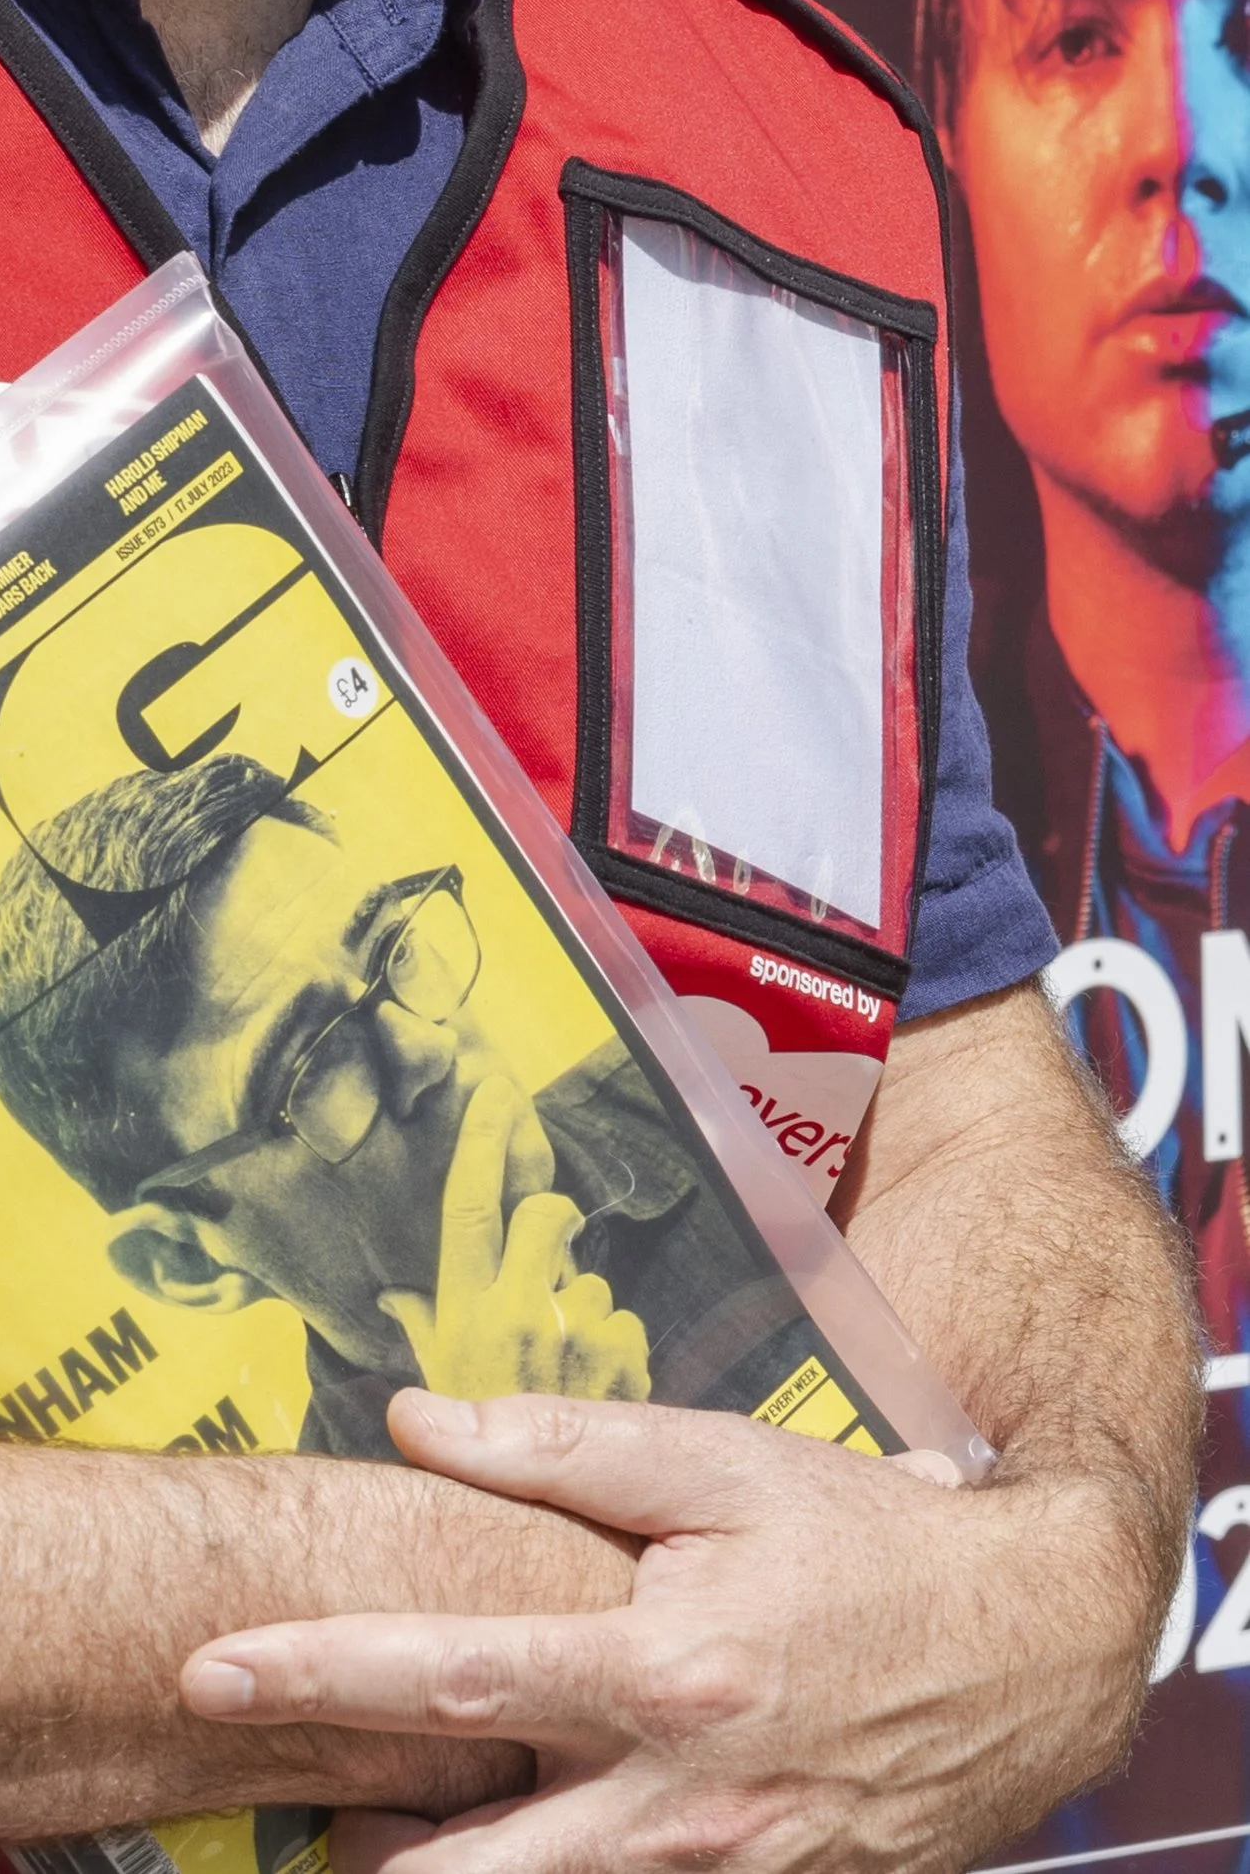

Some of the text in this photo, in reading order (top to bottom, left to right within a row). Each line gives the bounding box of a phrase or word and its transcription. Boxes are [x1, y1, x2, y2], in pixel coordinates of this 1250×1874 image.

[104, 409, 208, 499] HAROLD SHIPMAN
[115, 533, 146, 561] ISSUE
[142, 516, 167, 539] 1573
[175, 499, 187, 514] 17
[187, 480, 209, 506] JULY
[208, 461, 234, 487] 2023
[119, 470, 167, 516] AND ME
[19, 559, 57, 595] BACK
[336, 666, 368, 708] £4
[750, 955, 881, 1022] sponsored by
[768, 1387, 796, 1418] EVERY
[793, 1366, 820, 1393] WEEK
